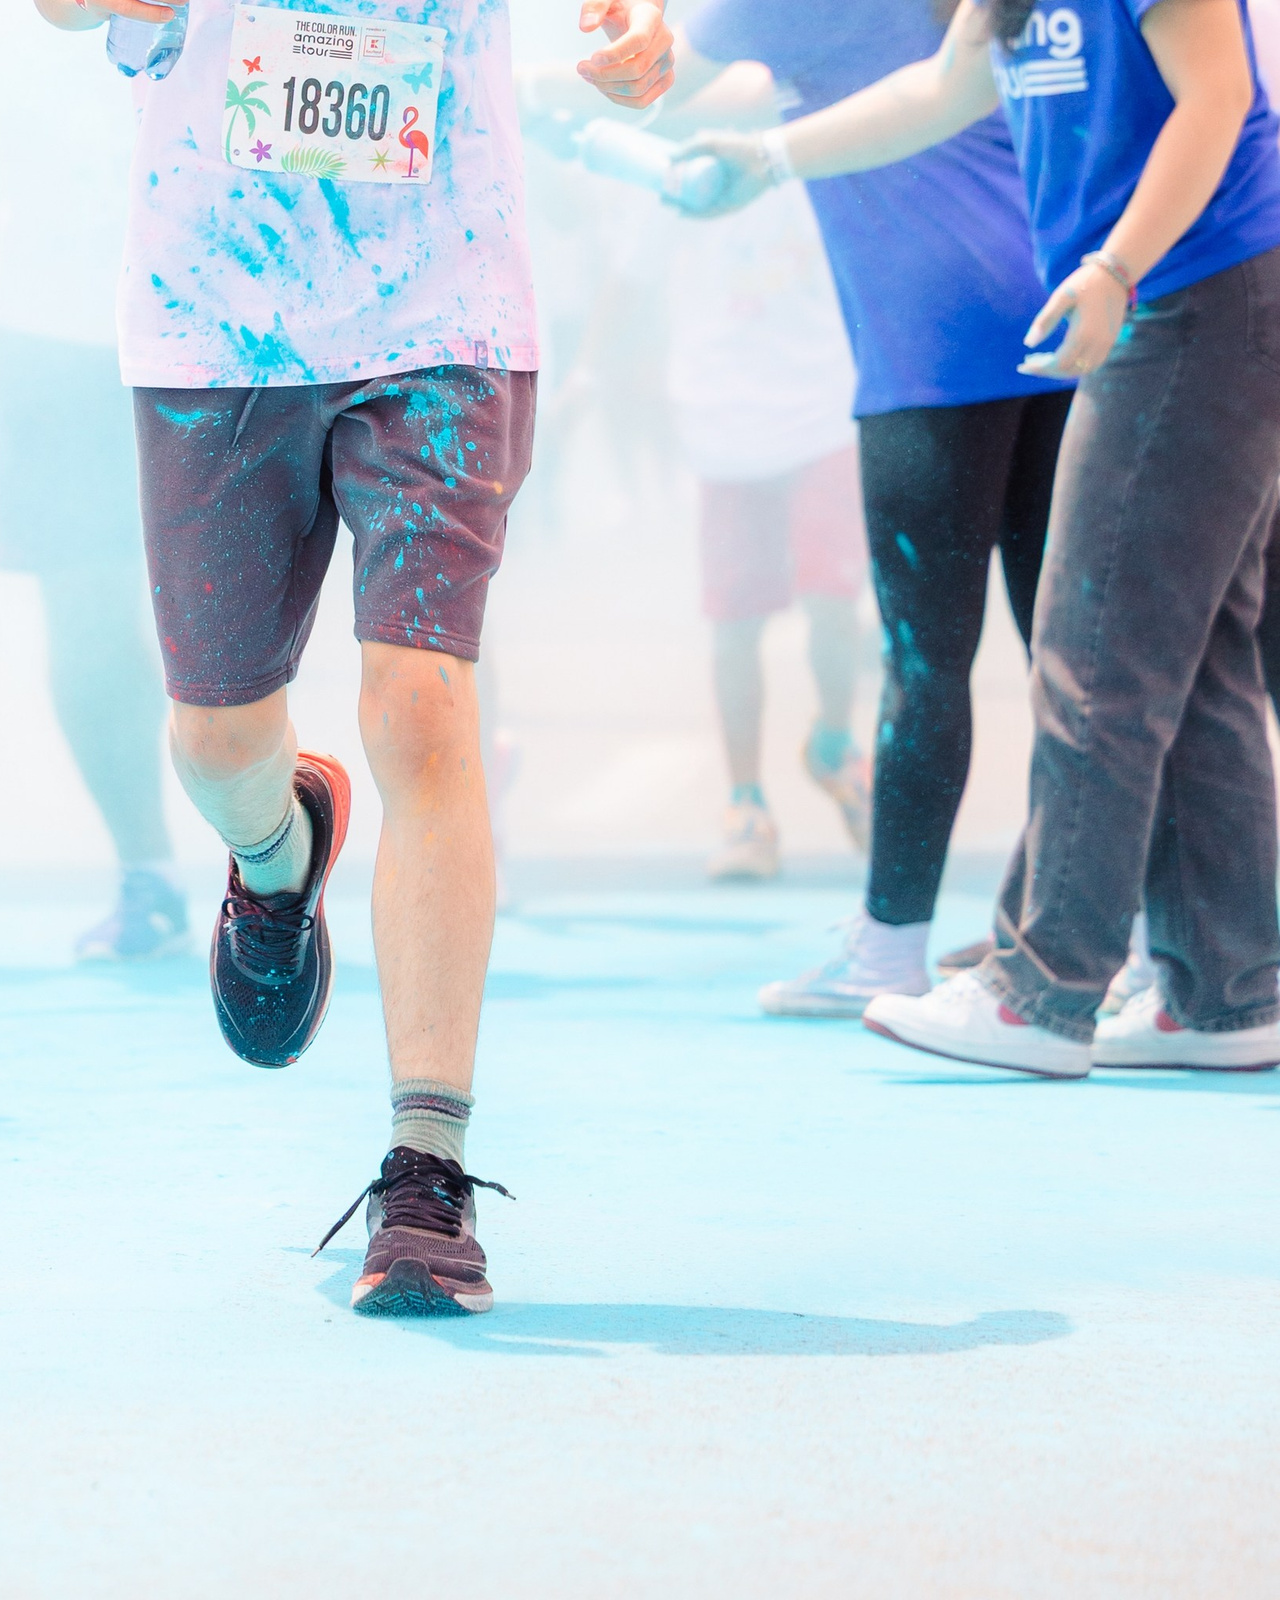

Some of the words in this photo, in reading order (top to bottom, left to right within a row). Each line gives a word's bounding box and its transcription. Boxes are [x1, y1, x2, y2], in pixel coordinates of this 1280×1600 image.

[296, 20, 311, 32] THE
[311, 21, 338, 35] COLOR
[293, 33, 354, 51] amazing
[301, 44, 329, 57] tour
[282, 76, 390, 141] 18360
